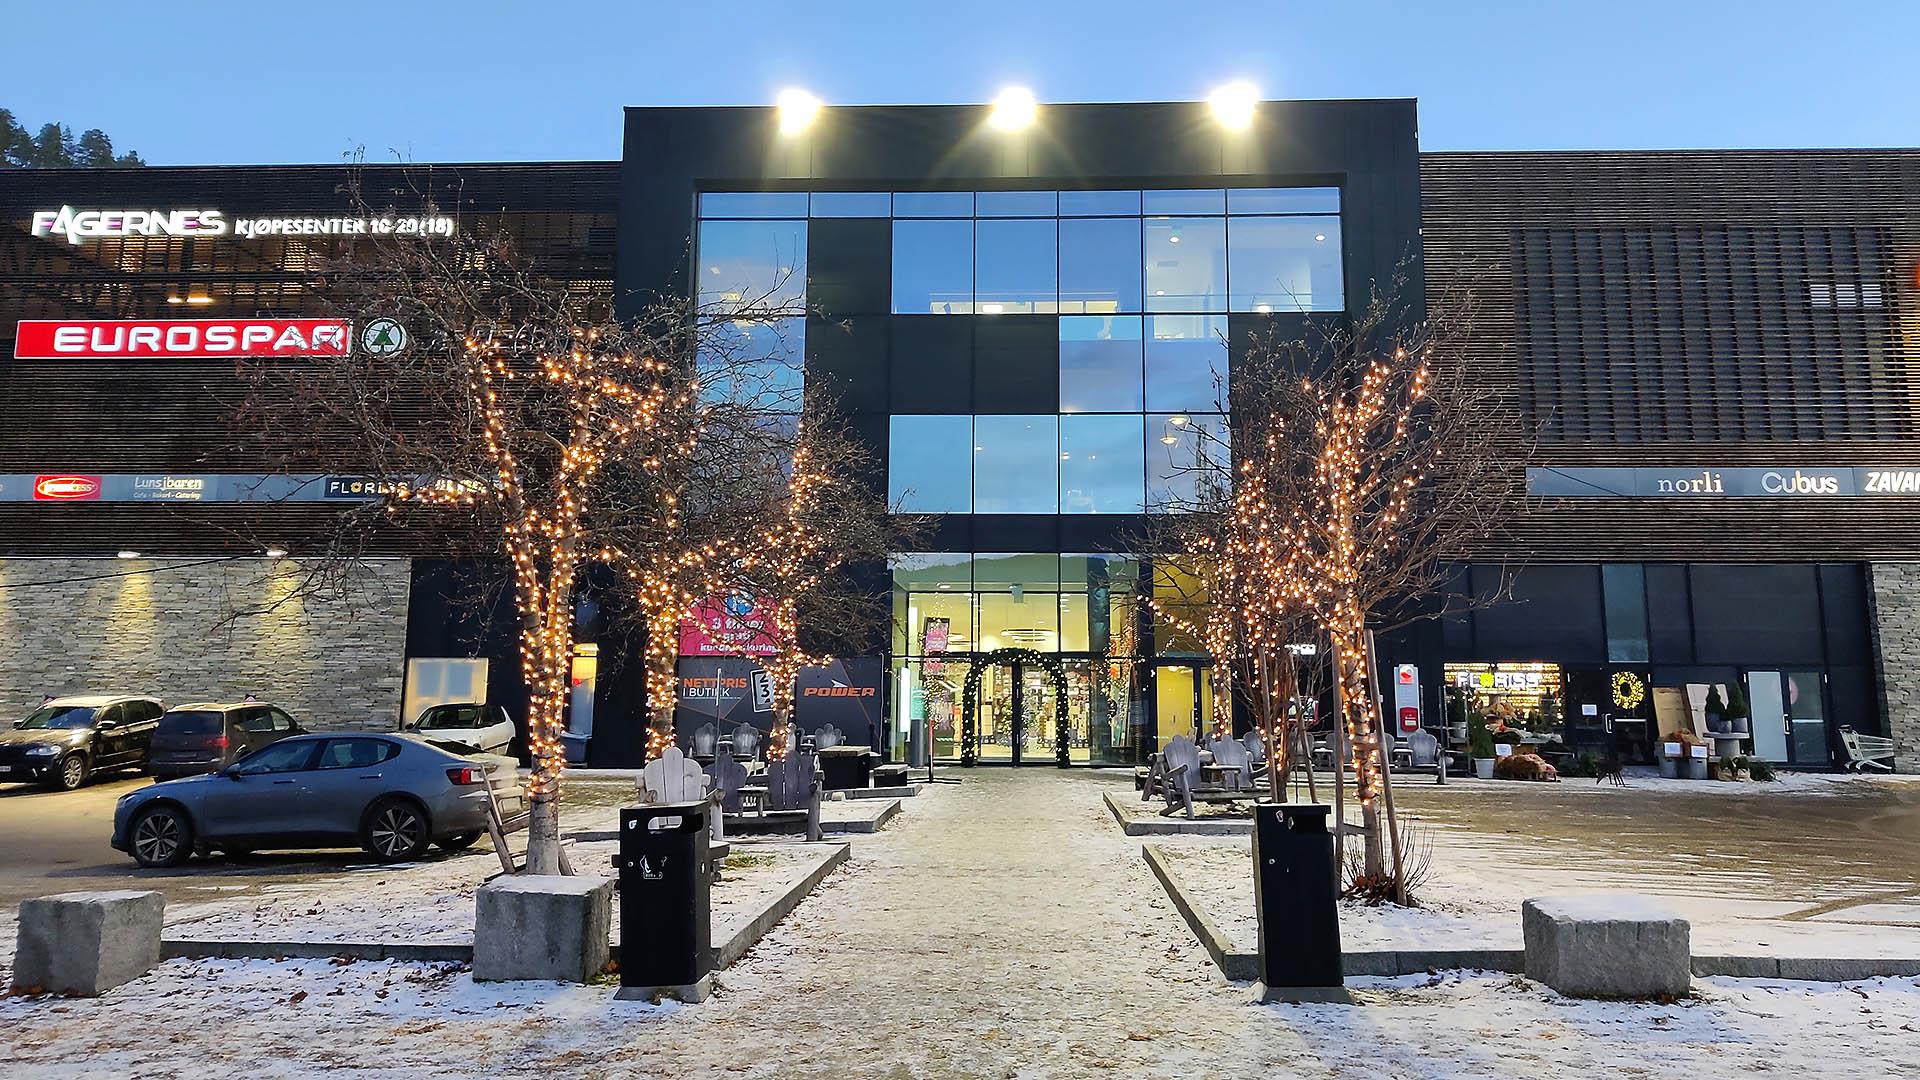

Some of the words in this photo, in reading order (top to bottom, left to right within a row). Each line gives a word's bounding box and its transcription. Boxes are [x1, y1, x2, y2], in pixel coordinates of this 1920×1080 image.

[31, 204, 225, 245] FAGERNES
[234, 218, 366, 238] KJØPESENTER
[53, 325, 343, 352] EUROSPAR
[134, 476, 203, 491] Lunsjbaren
[1658, 471, 1724, 493] norli
[1761, 470, 1838, 494] Cubus
[683, 678, 747, 688] NETTPRIS
[1457, 672, 1539, 687] FLORISS
[804, 687, 875, 697] POWER
